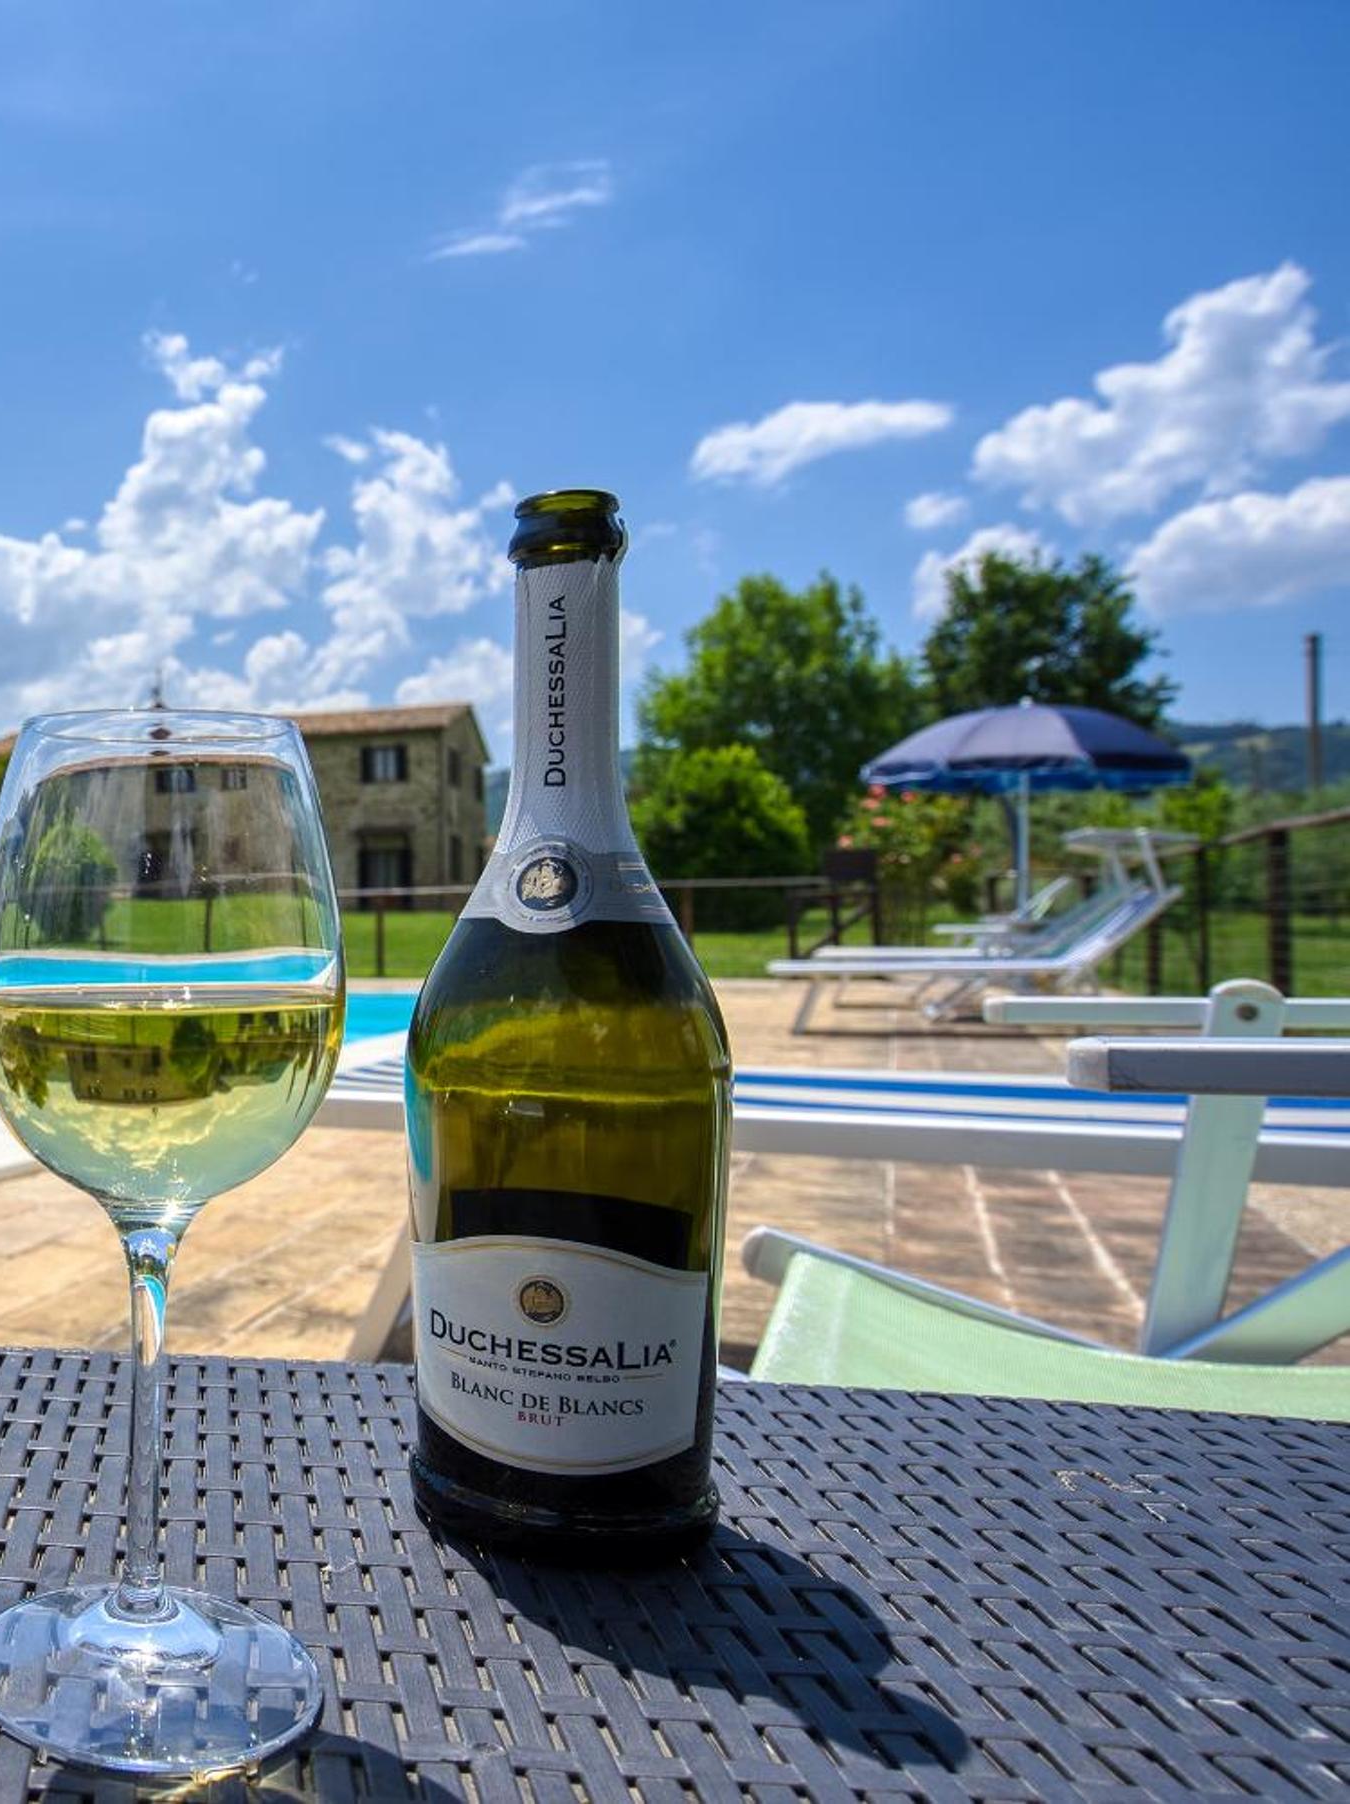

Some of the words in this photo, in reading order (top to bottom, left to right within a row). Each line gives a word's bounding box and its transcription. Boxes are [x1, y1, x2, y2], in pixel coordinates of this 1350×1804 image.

[544, 594, 566, 788] DUCHESSALIA
[469, 1356, 508, 1371] SANTO
[451, 1370, 515, 1406] BLANC
[521, 1392, 551, 1413] DE
[559, 1395, 645, 1416] BLANCS
[517, 1410, 566, 1427] BRUT
